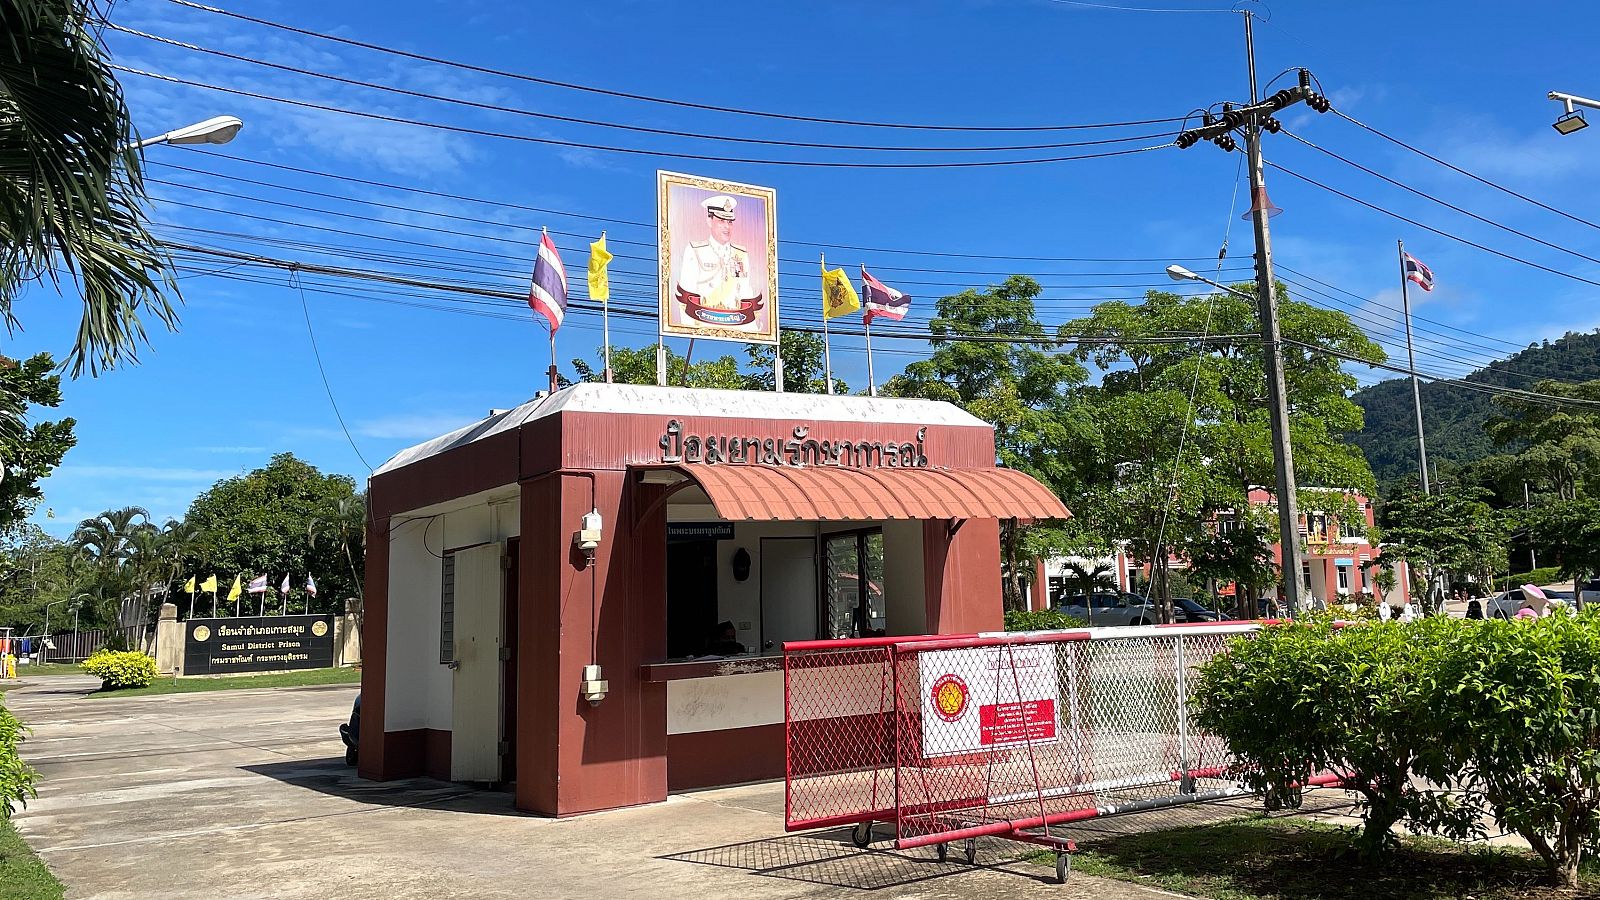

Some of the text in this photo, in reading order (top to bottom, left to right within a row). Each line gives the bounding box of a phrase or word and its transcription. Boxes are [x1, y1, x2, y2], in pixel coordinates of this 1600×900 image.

[659, 419, 928, 468] ป้อมยามรักษาการณ์
[218, 625, 305, 637] เรือนจำอำเภอเกาะสมุย
[221, 640, 301, 651] Samui District Prison
[211, 653, 308, 664] กรมราชทัณฑ์ กระทรวงยุติธรรม
